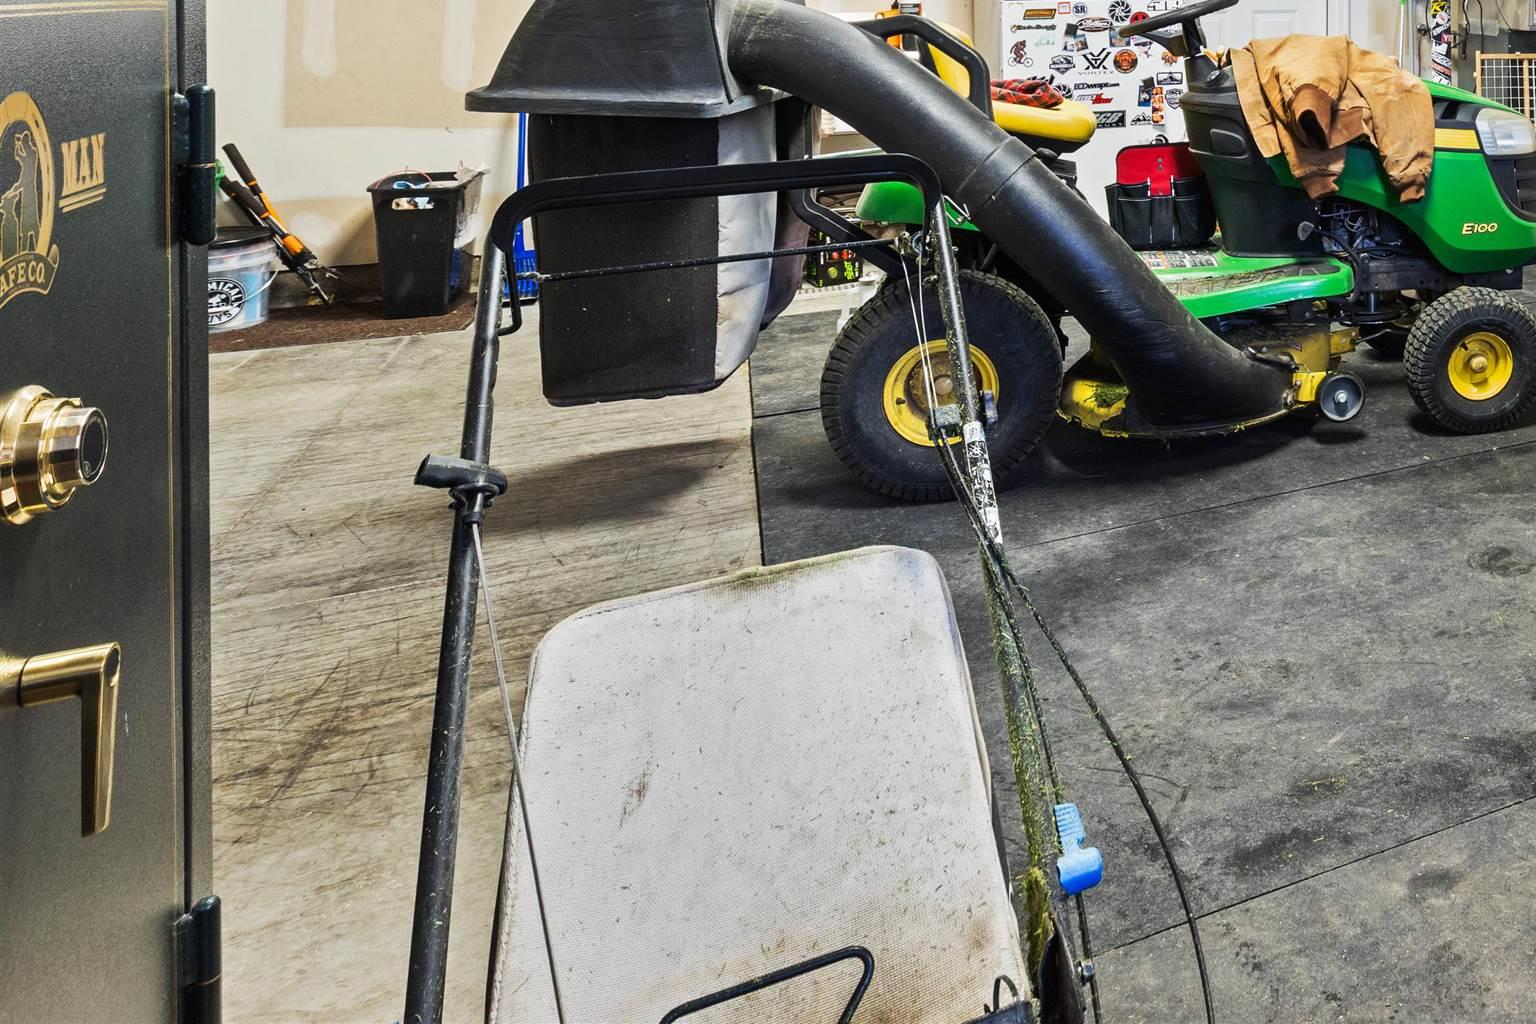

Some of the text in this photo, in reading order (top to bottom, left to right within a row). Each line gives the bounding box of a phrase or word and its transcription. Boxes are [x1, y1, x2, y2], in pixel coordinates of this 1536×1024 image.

[1075, 6, 1085, 14] SR
[61, 132, 105, 197] MAN
[1461, 222, 1498, 235] E100
[0, 260, 45, 296] AFE CO.
[207, 282, 243, 301] MICAL
